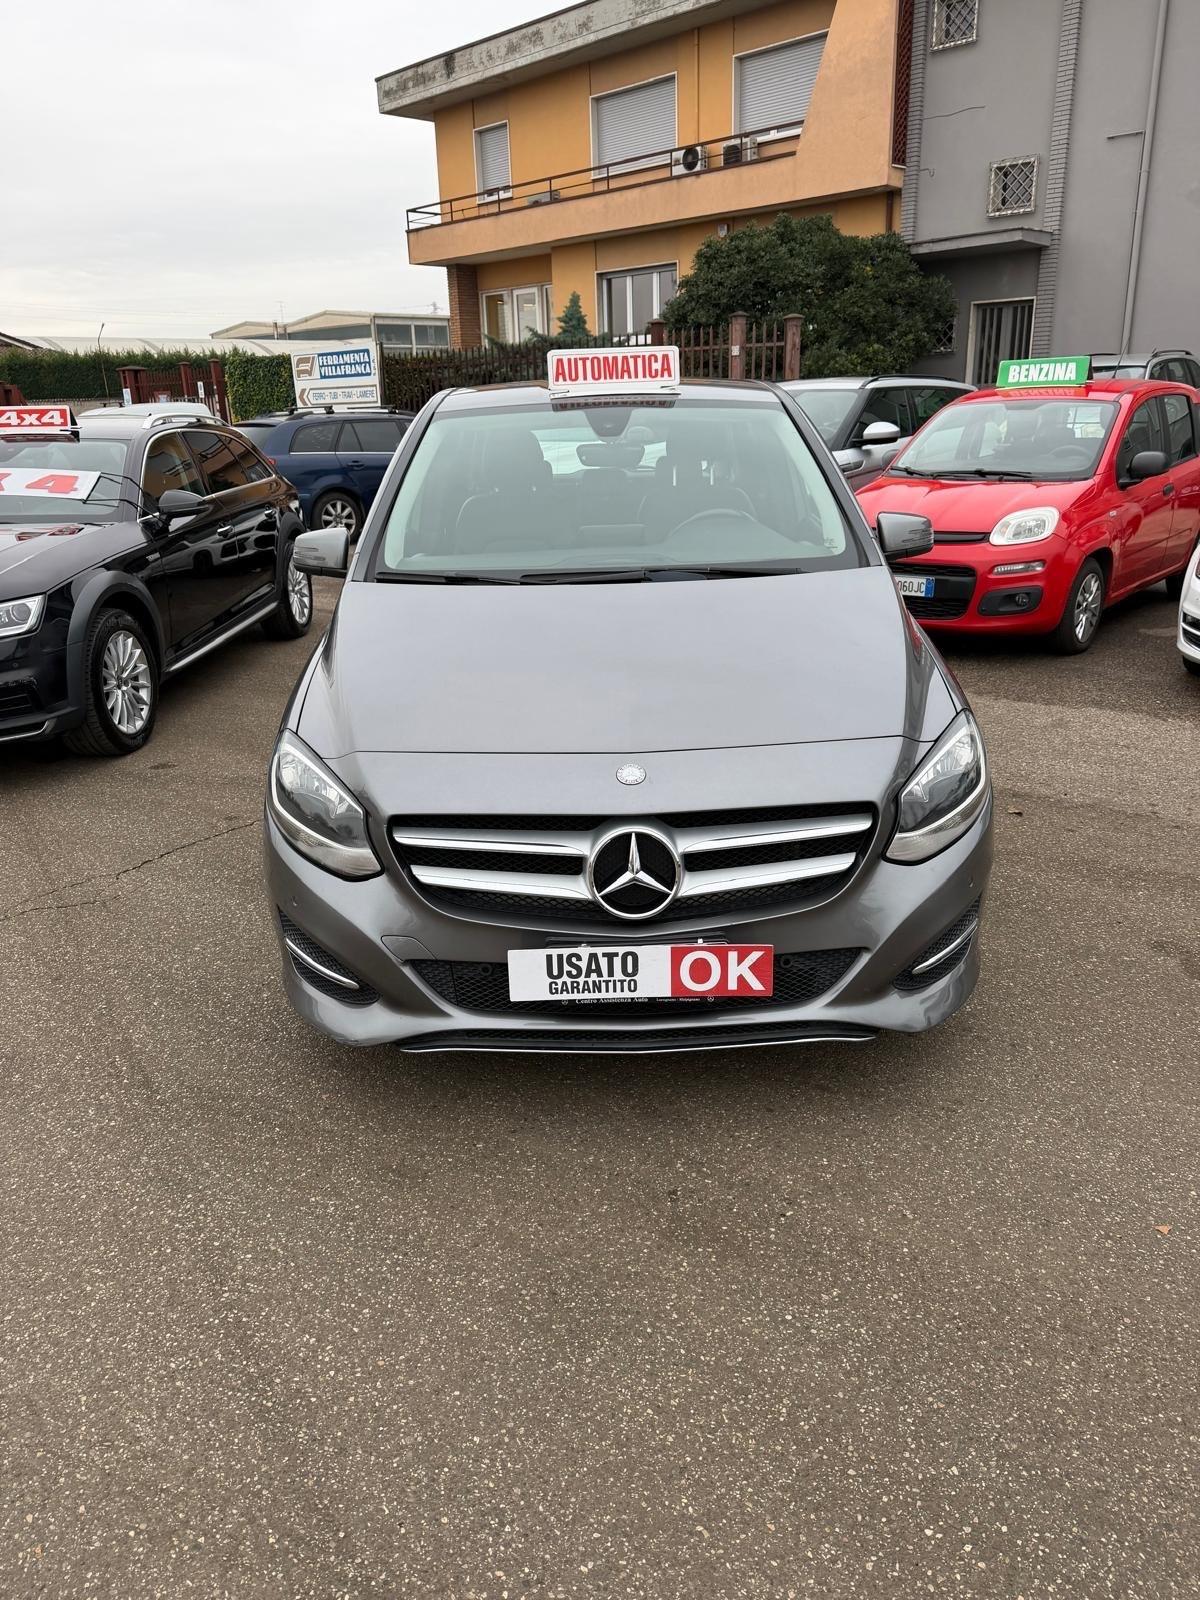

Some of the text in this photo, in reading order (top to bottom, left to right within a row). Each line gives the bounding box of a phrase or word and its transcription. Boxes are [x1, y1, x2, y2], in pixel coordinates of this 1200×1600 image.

[319, 352, 369, 366] FERRAMENTA
[555, 353, 672, 382] AUTOMATICA
[320, 363, 370, 376] VILLAFRANCA
[1008, 362, 1077, 383] BENZINA
[0, 411, 64, 425] 4x4
[546, 951, 638, 980] USATO
[679, 950, 767, 992] OK
[548, 978, 638, 995] GARANTITO
